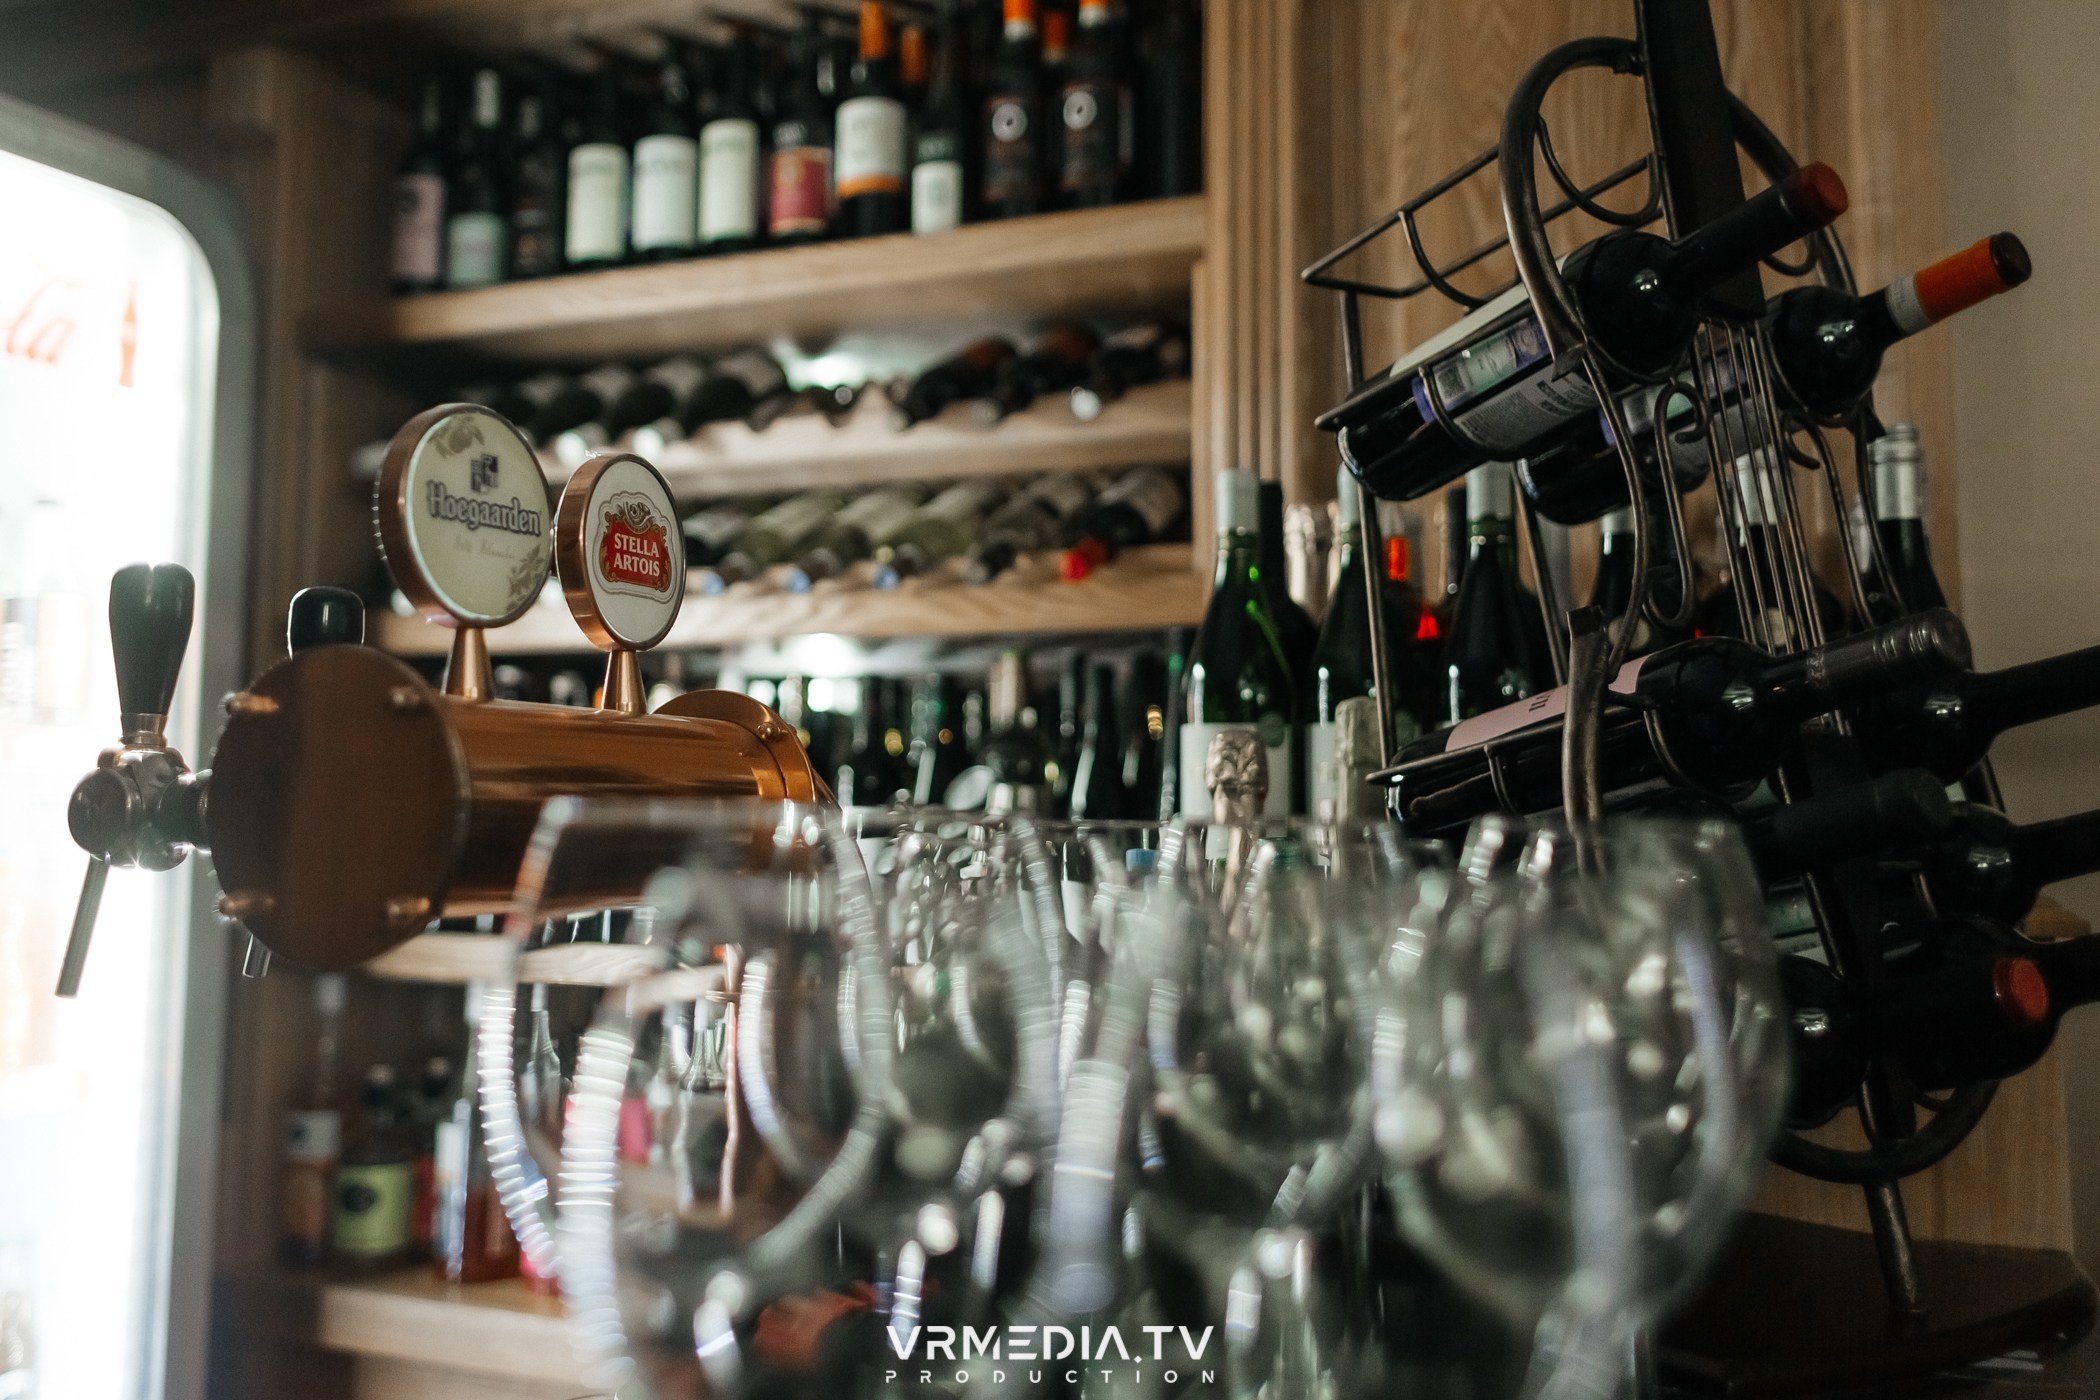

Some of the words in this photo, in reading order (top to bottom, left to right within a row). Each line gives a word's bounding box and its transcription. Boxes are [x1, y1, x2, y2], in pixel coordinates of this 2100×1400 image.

[426, 480, 541, 536] Hoegaarden
[614, 532, 660, 558] STELLA
[613, 552, 660, 577] ARTOIS
